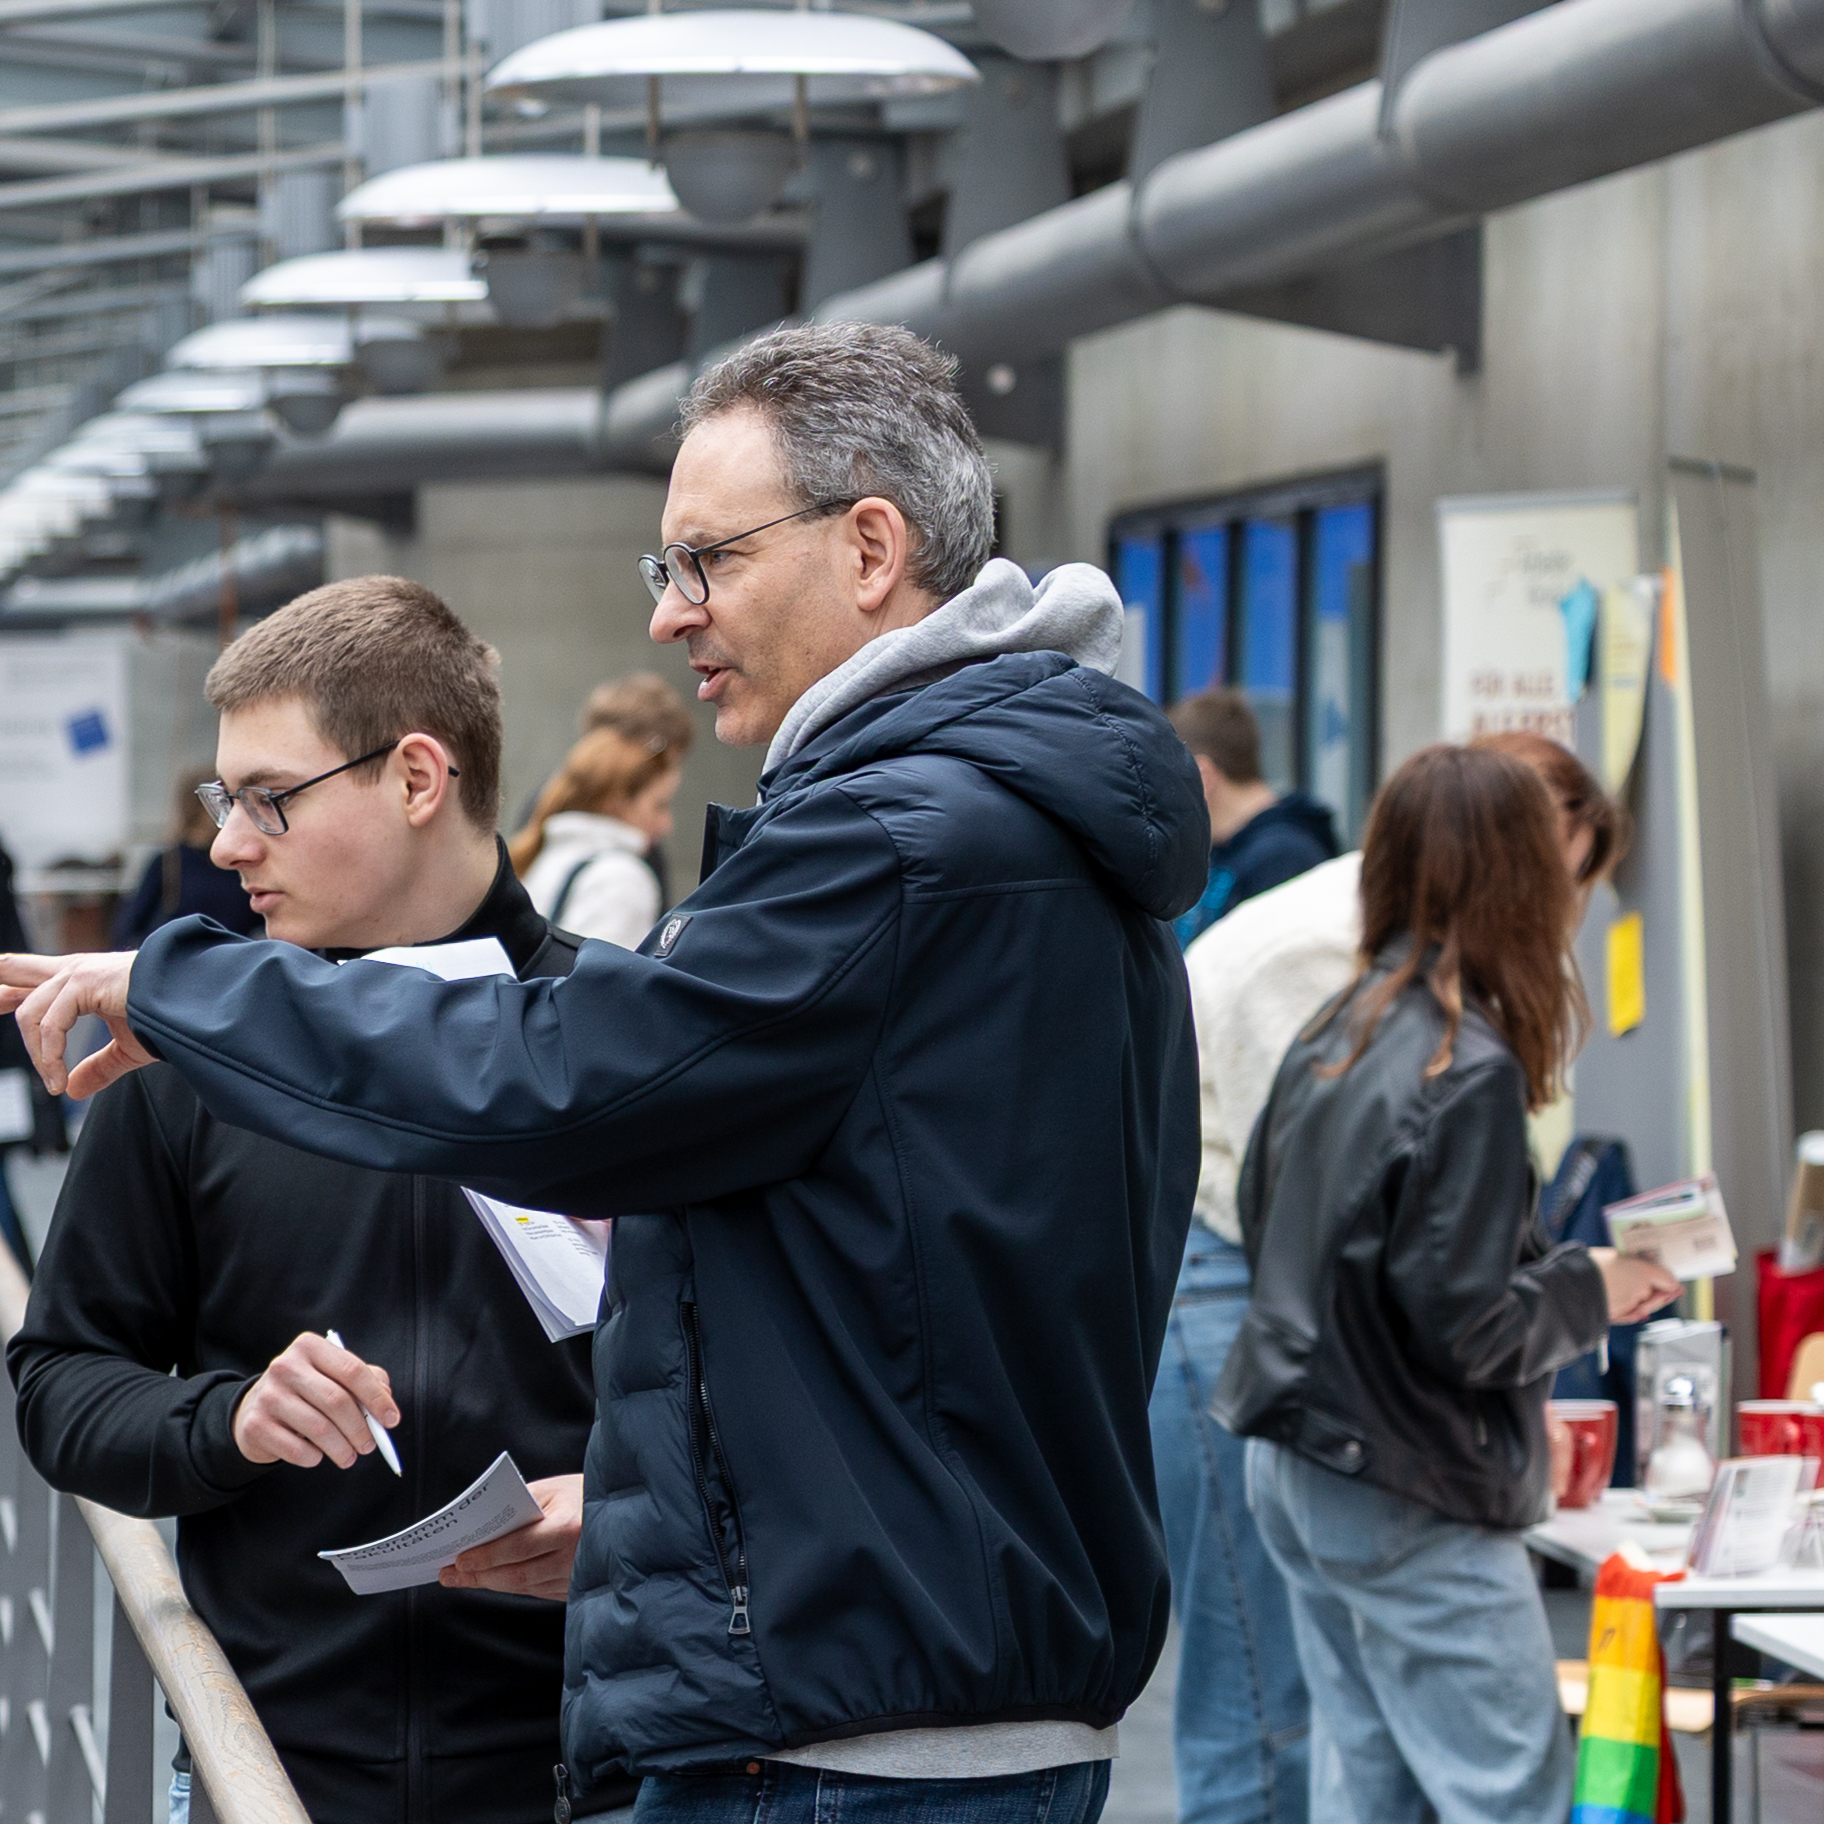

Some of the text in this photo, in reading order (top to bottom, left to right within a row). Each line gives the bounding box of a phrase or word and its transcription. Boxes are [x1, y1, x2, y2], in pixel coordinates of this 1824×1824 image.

[335, 1511, 454, 1558] Programm
[458, 1481, 489, 1511] der
[339, 1518, 458, 1561] Fakultäten
